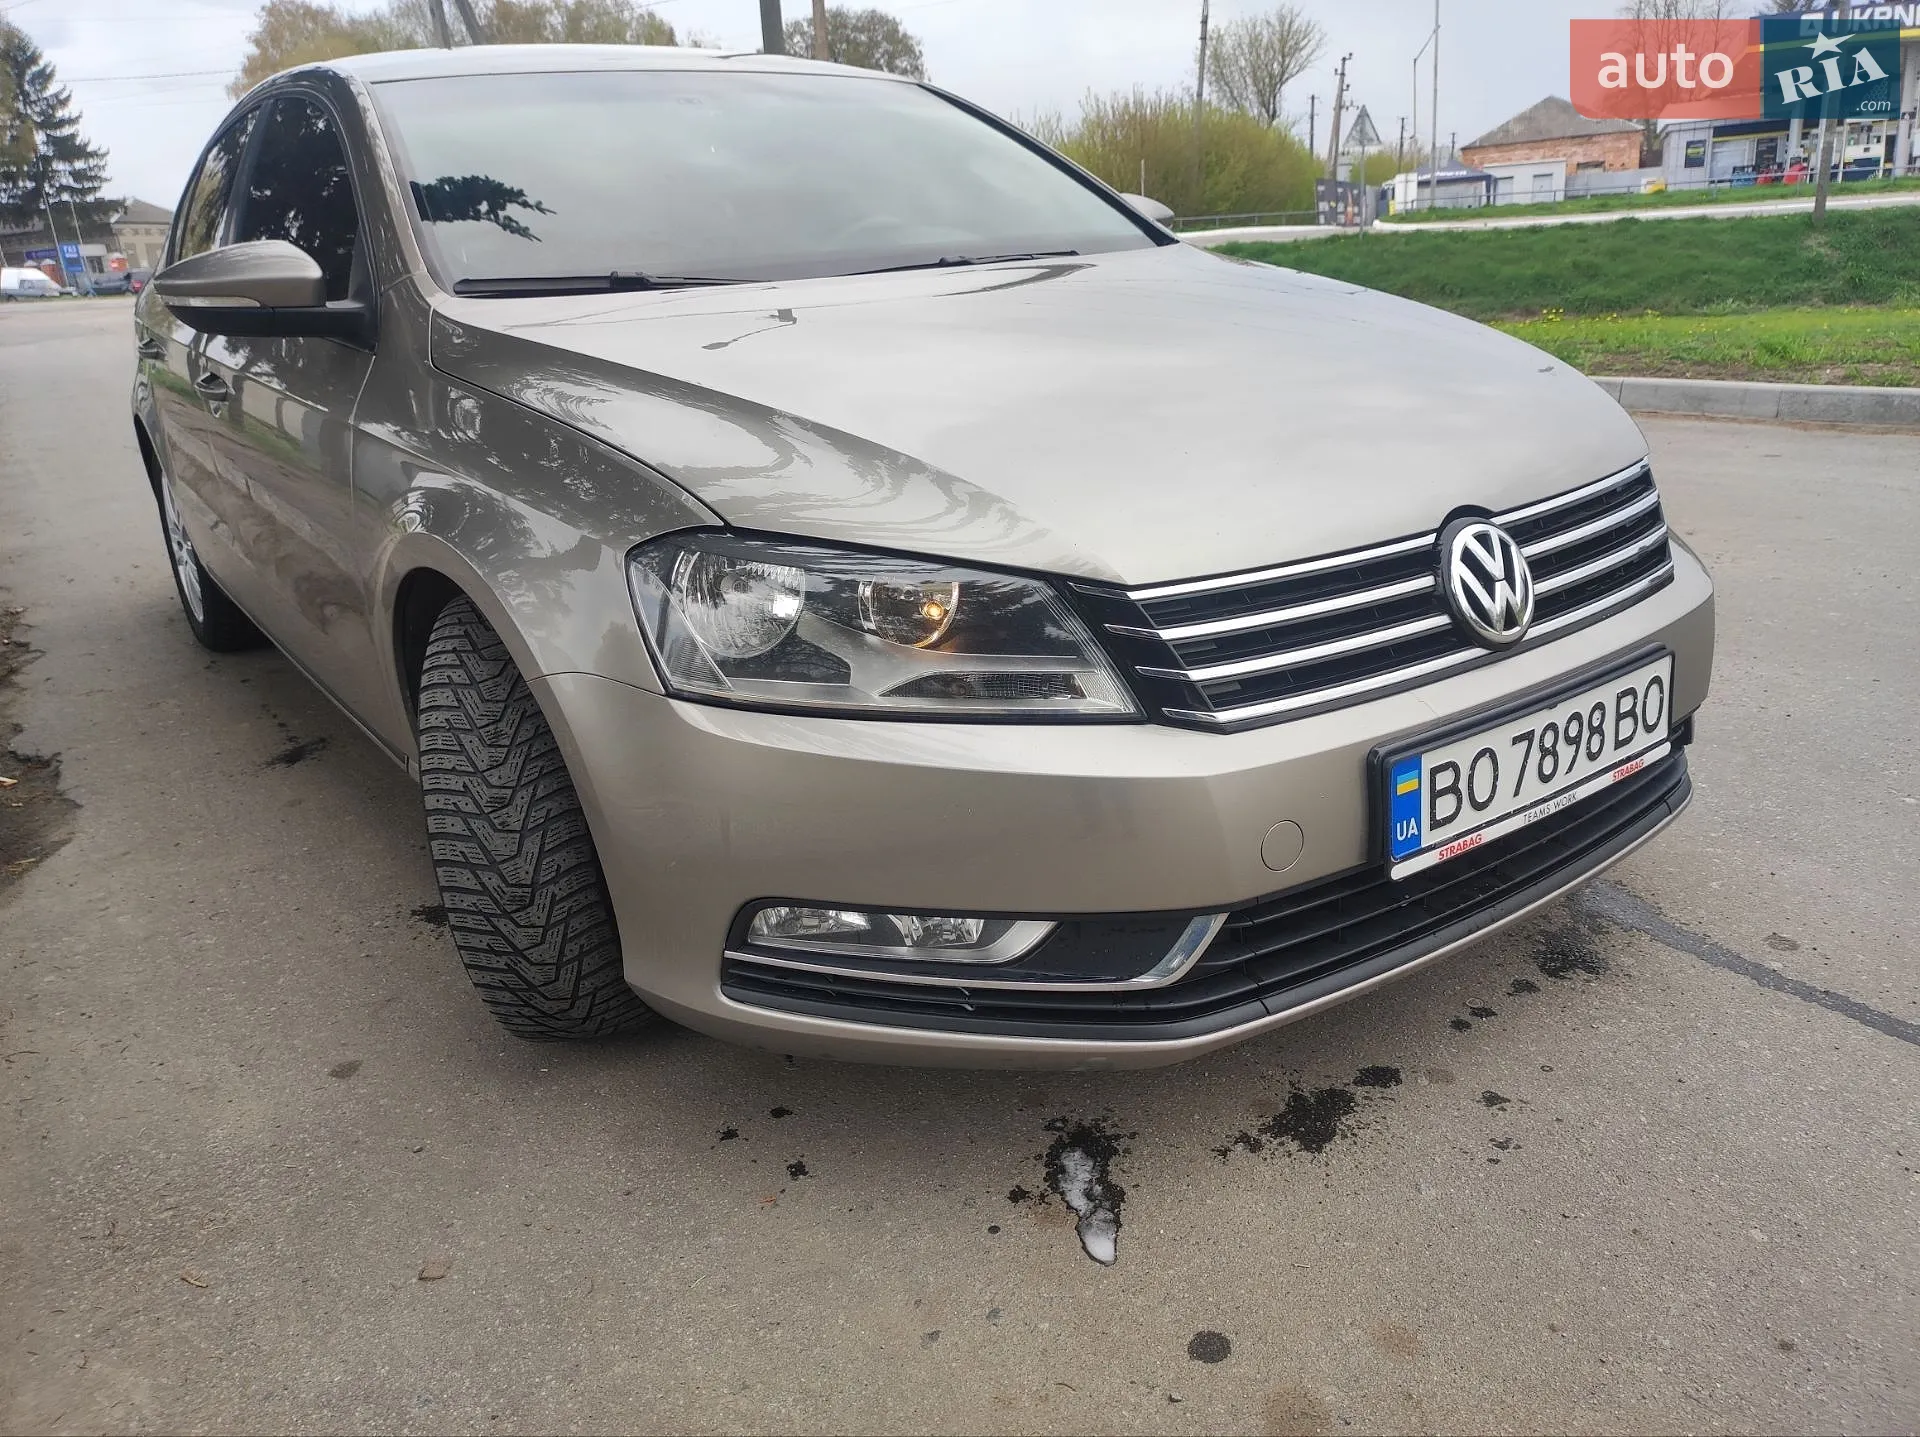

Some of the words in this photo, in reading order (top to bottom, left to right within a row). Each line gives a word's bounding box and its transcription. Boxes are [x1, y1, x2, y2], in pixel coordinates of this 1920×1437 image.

[1831, 3, 1920, 34] UKRN
[1430, 747, 1499, 832] BO
[1512, 701, 1606, 798] 7898
[1614, 675, 1664, 751] BO
[1612, 759, 1645, 782] STRABAG
[1523, 804, 1551, 824] TEAMS
[1552, 791, 1577, 811] WORK
[1396, 817, 1419, 841] UA
[1438, 834, 1482, 861] STRABAG
